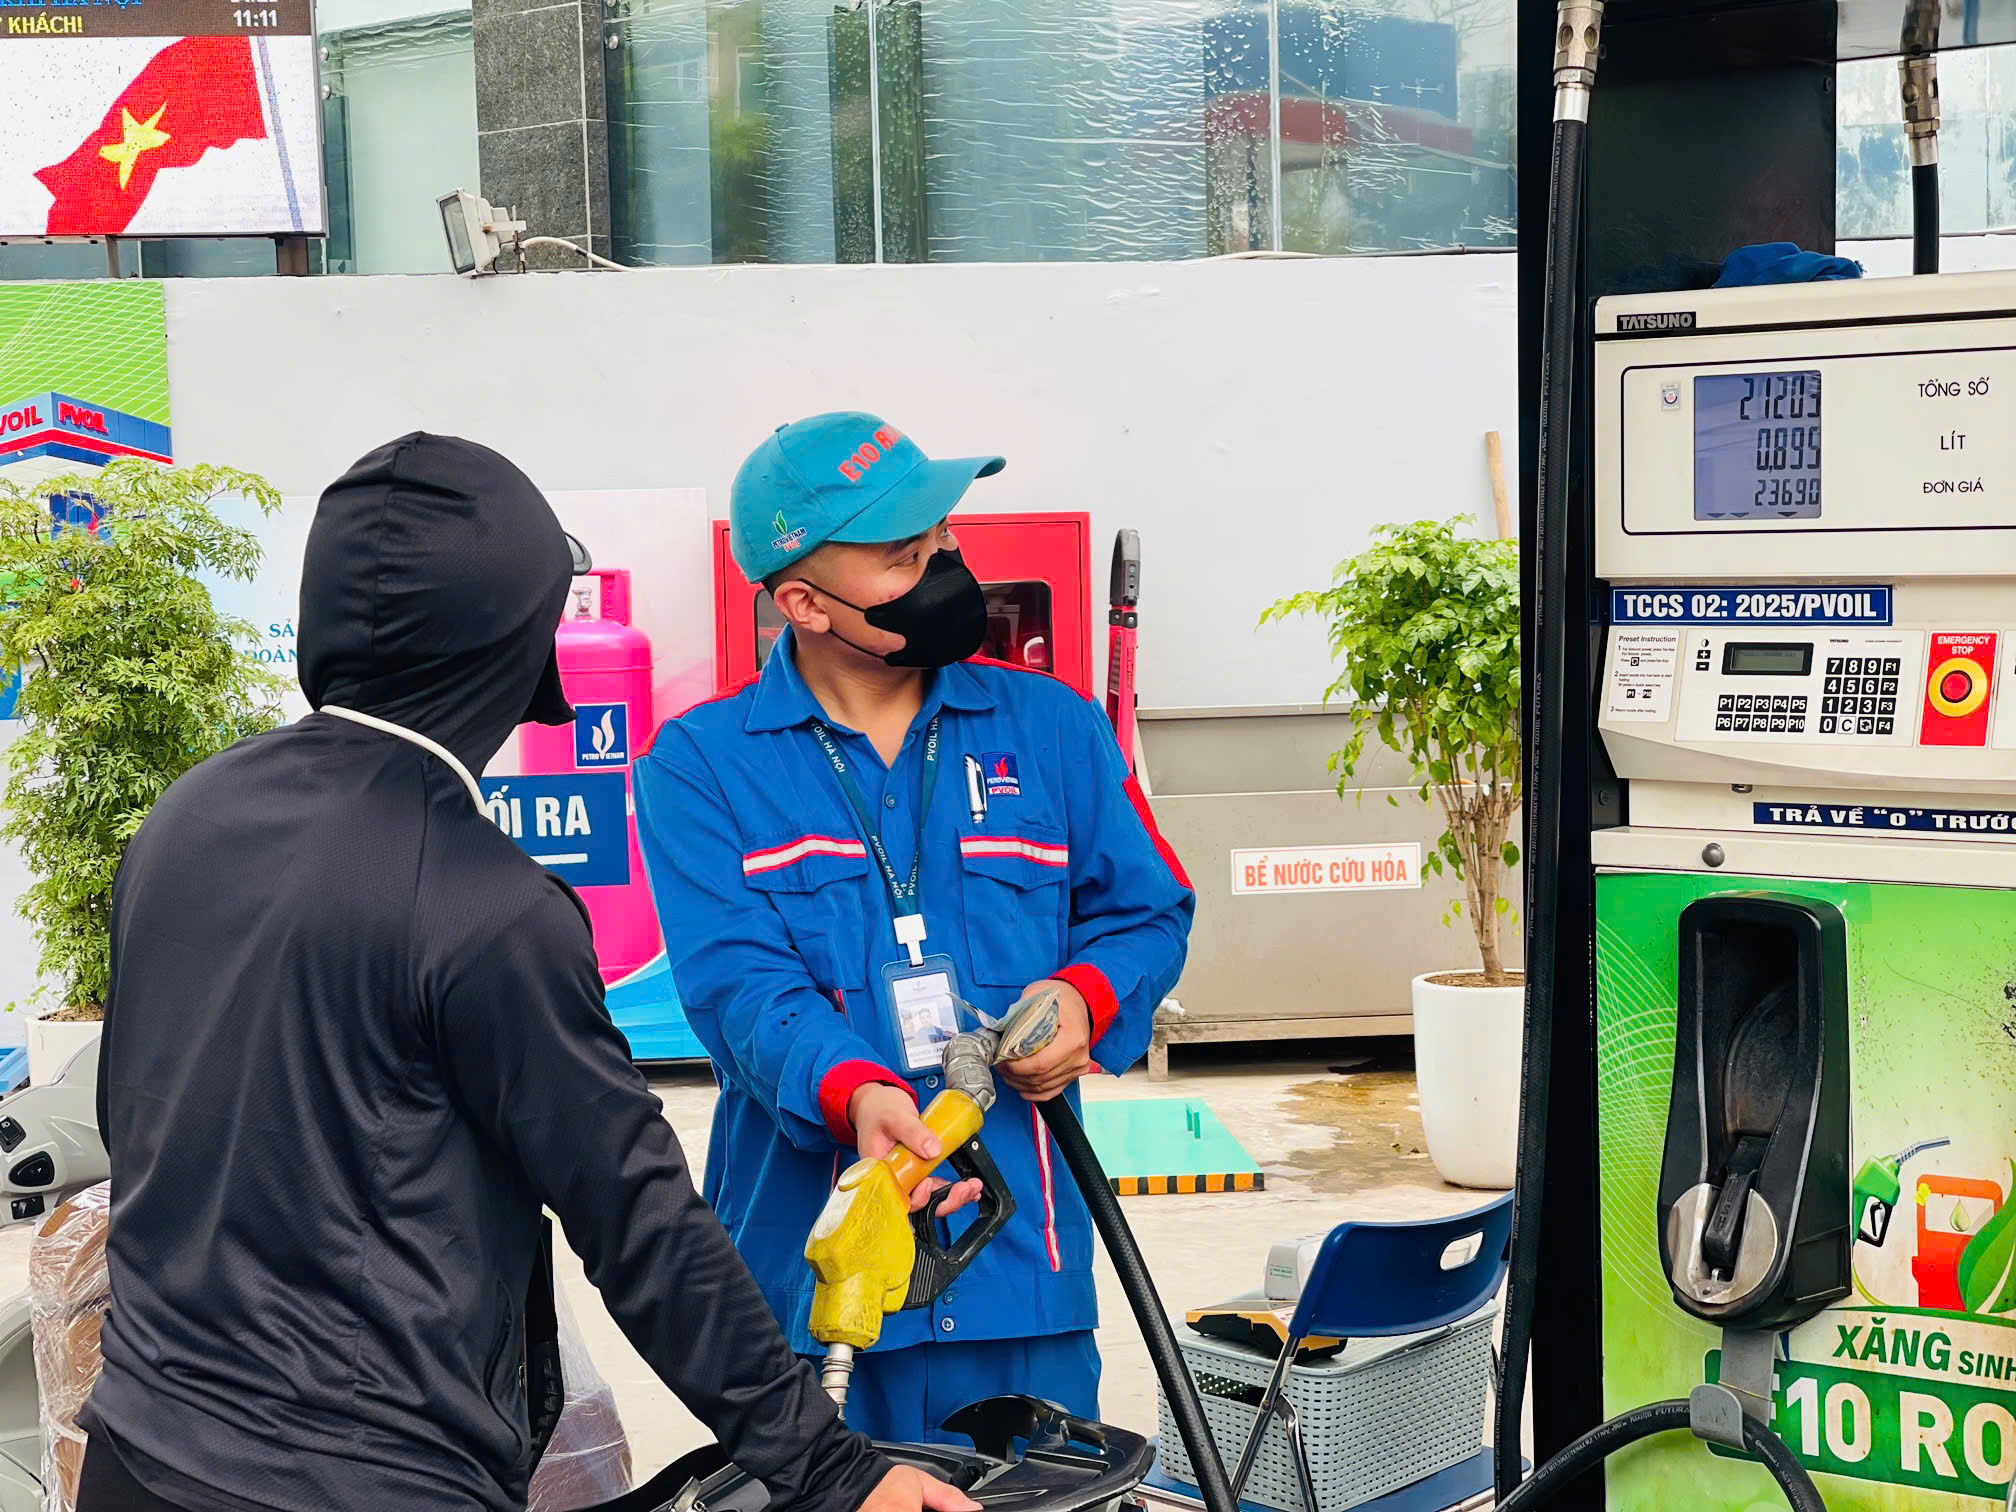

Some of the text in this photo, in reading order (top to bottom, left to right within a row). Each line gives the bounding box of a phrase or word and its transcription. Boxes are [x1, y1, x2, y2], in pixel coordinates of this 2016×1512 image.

[8, 11, 84, 34] KHÁCH!
[233, 9, 278, 27] 11:11
[1620, 313, 1693, 330] TATSUNO
[1917, 375, 1990, 398] TỔNG SỐ
[58, 401, 109, 436] PVOIL
[1940, 430, 1966, 450] LÍT
[839, 442, 881, 483] E10
[1755, 478, 1820, 506] 23690
[1923, 476, 1985, 494] ĐƠN GIÁ
[1623, 593, 1877, 618] TCCS 02: 2025/PVOIL
[1618, 635, 1677, 643] Preset Instruction
[1937, 635, 1991, 645] EMERGENCY
[1951, 645, 1975, 655] STOP
[1830, 659, 1897, 674] 7 8 9 F1
[1827, 679, 1896, 693] 4 5 6 F2
[1719, 698, 1806, 710] P1 P2 P3 P4 P5
[1826, 698, 1893, 713] 1 2 3 F3
[1717, 717, 1805, 729] P6 P7 P8 P9 P10
[1823, 718, 1891, 732] 0 C F4
[927, 732, 938, 761] PVOIL
[535, 794, 592, 837] RA
[1769, 804, 1823, 824] TRẢ
[1829, 806, 1864, 825] VỀ
[1245, 852, 1408, 887] BỂ NƯỚC CỨU HỎA
[1832, 1316, 1952, 1372] XĂNG
